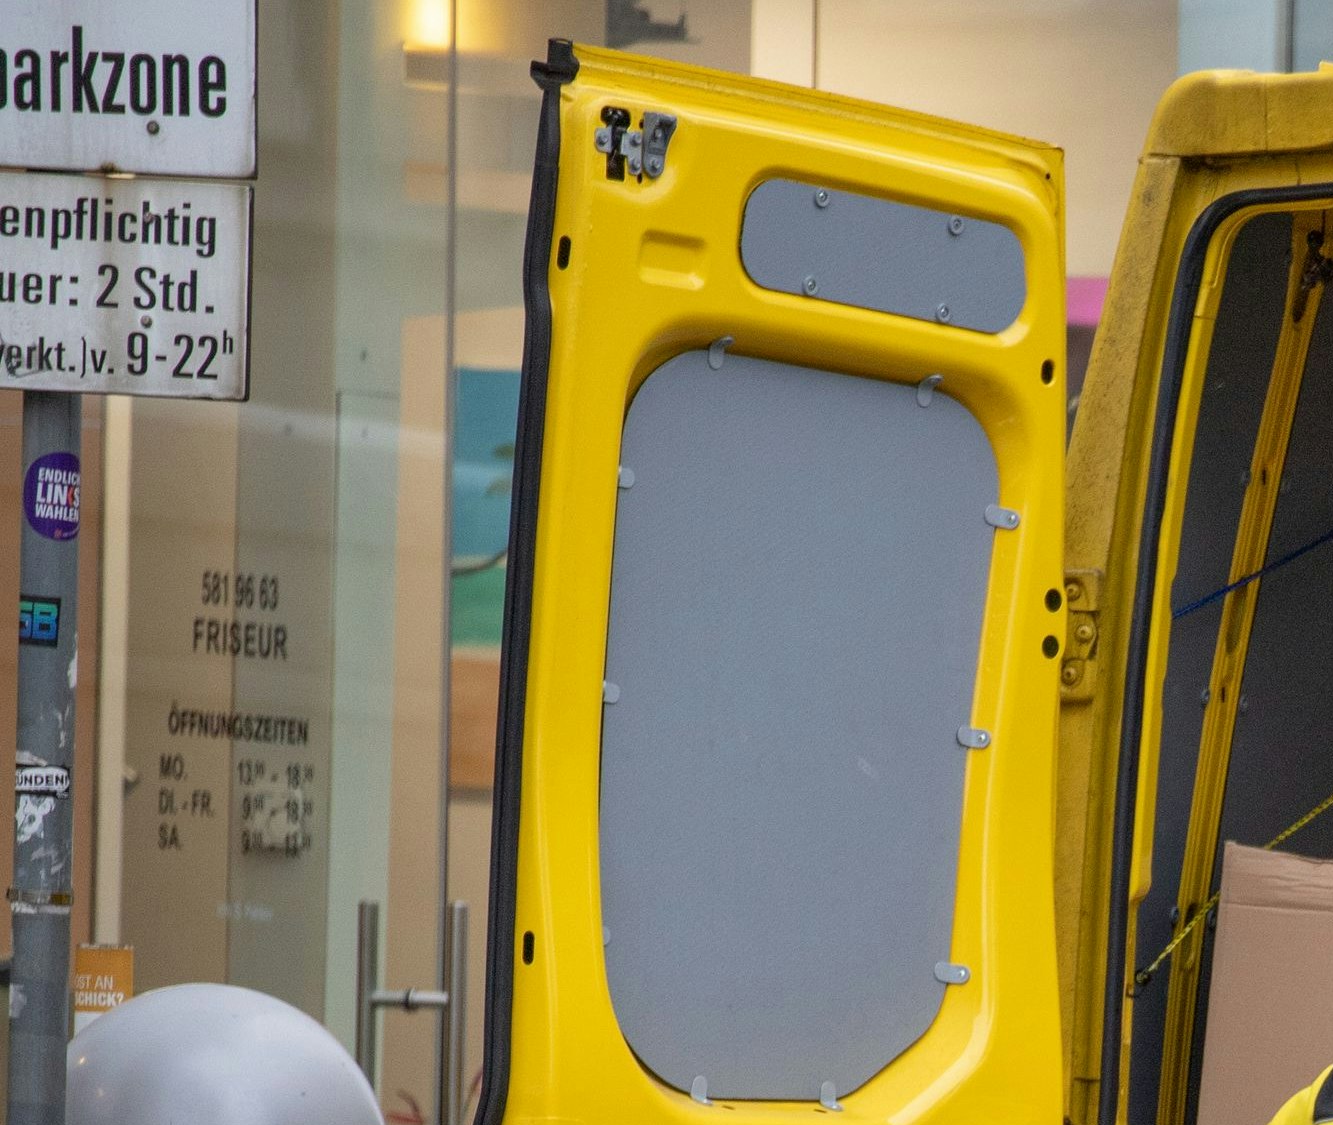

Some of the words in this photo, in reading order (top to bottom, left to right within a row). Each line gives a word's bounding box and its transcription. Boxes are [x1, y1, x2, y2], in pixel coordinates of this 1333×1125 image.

[0, 197, 217, 258] enpflichtig
[96, 264, 120, 308] 2
[133, 266, 214, 313] Std.
[202, 570, 229, 605] 581
[192, 615, 289, 660] FRISEUR
[167, 702, 309, 746] ÖFFNUNGSZEITEN
